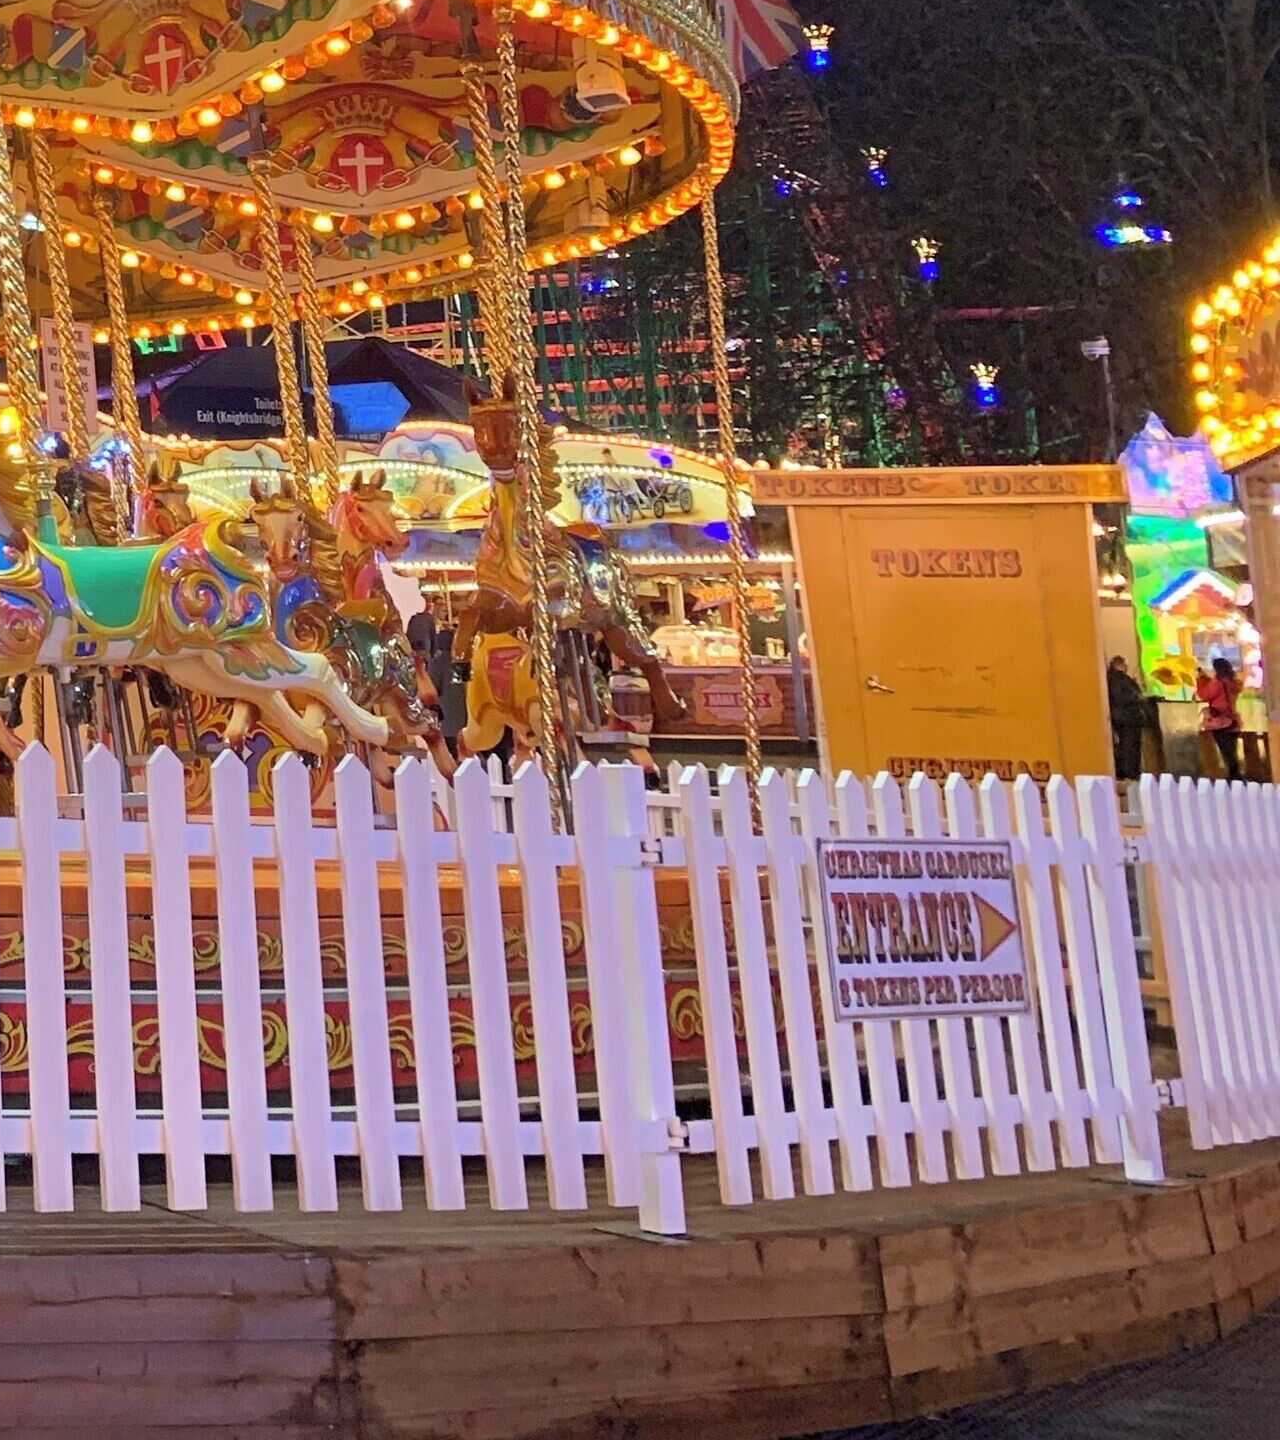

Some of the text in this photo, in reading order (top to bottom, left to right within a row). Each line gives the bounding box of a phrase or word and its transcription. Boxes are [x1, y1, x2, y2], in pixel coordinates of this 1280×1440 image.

[197, 410, 214, 422] Exit
[756, 473, 907, 499] TOKENS
[960, 472, 1080, 496] TOKEN
[871, 548, 1023, 578] TOKENS
[824, 849, 1011, 880] CHRISTMAS CAROUSEL
[830, 891, 977, 964] ENTRANCE
[852, 975, 922, 1007] TOKENS
[922, 974, 958, 1005] PER
[958, 972, 1025, 1004] PERSON
